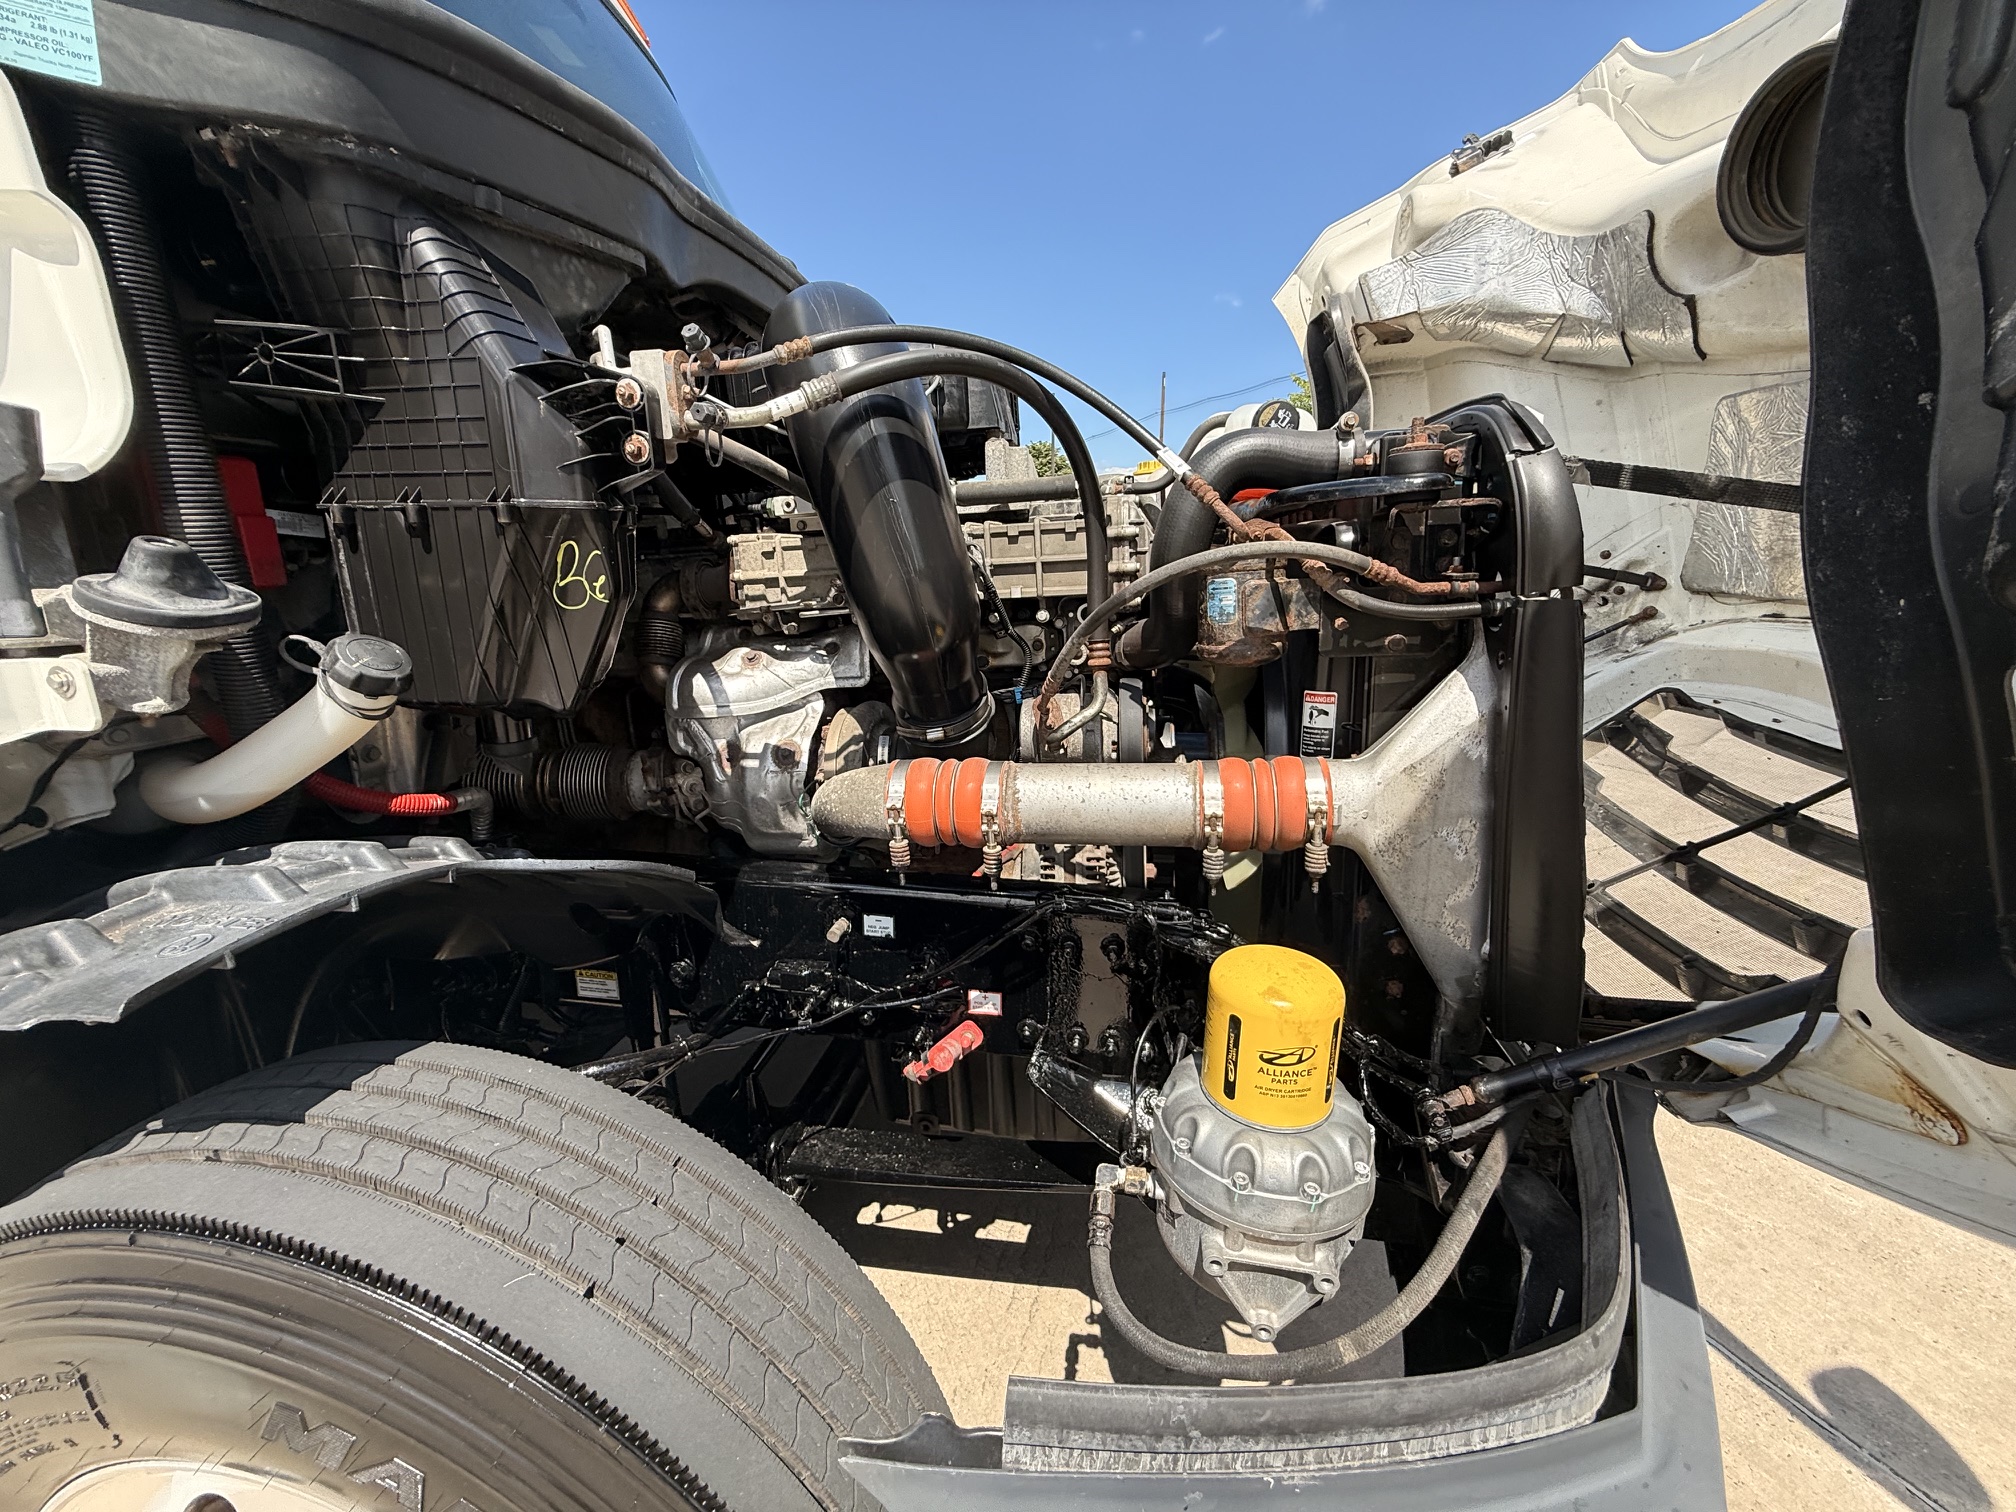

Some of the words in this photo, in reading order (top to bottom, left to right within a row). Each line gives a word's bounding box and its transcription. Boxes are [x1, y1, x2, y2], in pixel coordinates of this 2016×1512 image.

[30, 21, 48, 32] 2.88
[49, 26, 58, 34] lb
[80, 34, 93, 44] kg)
[14, 36, 49, 52] VALEO
[51, 46, 94, 62] VC100YF
[1311, 695, 1335, 703] DANGER
[585, 971, 614, 979] CAUTION
[1257, 1066, 1313, 1078] ALLIANCE
[1271, 1077, 1298, 1085] PARTS
[1264, 1086, 1283, 1094] DRYER
[1283, 1086, 1312, 1094] CARTRIDGE
